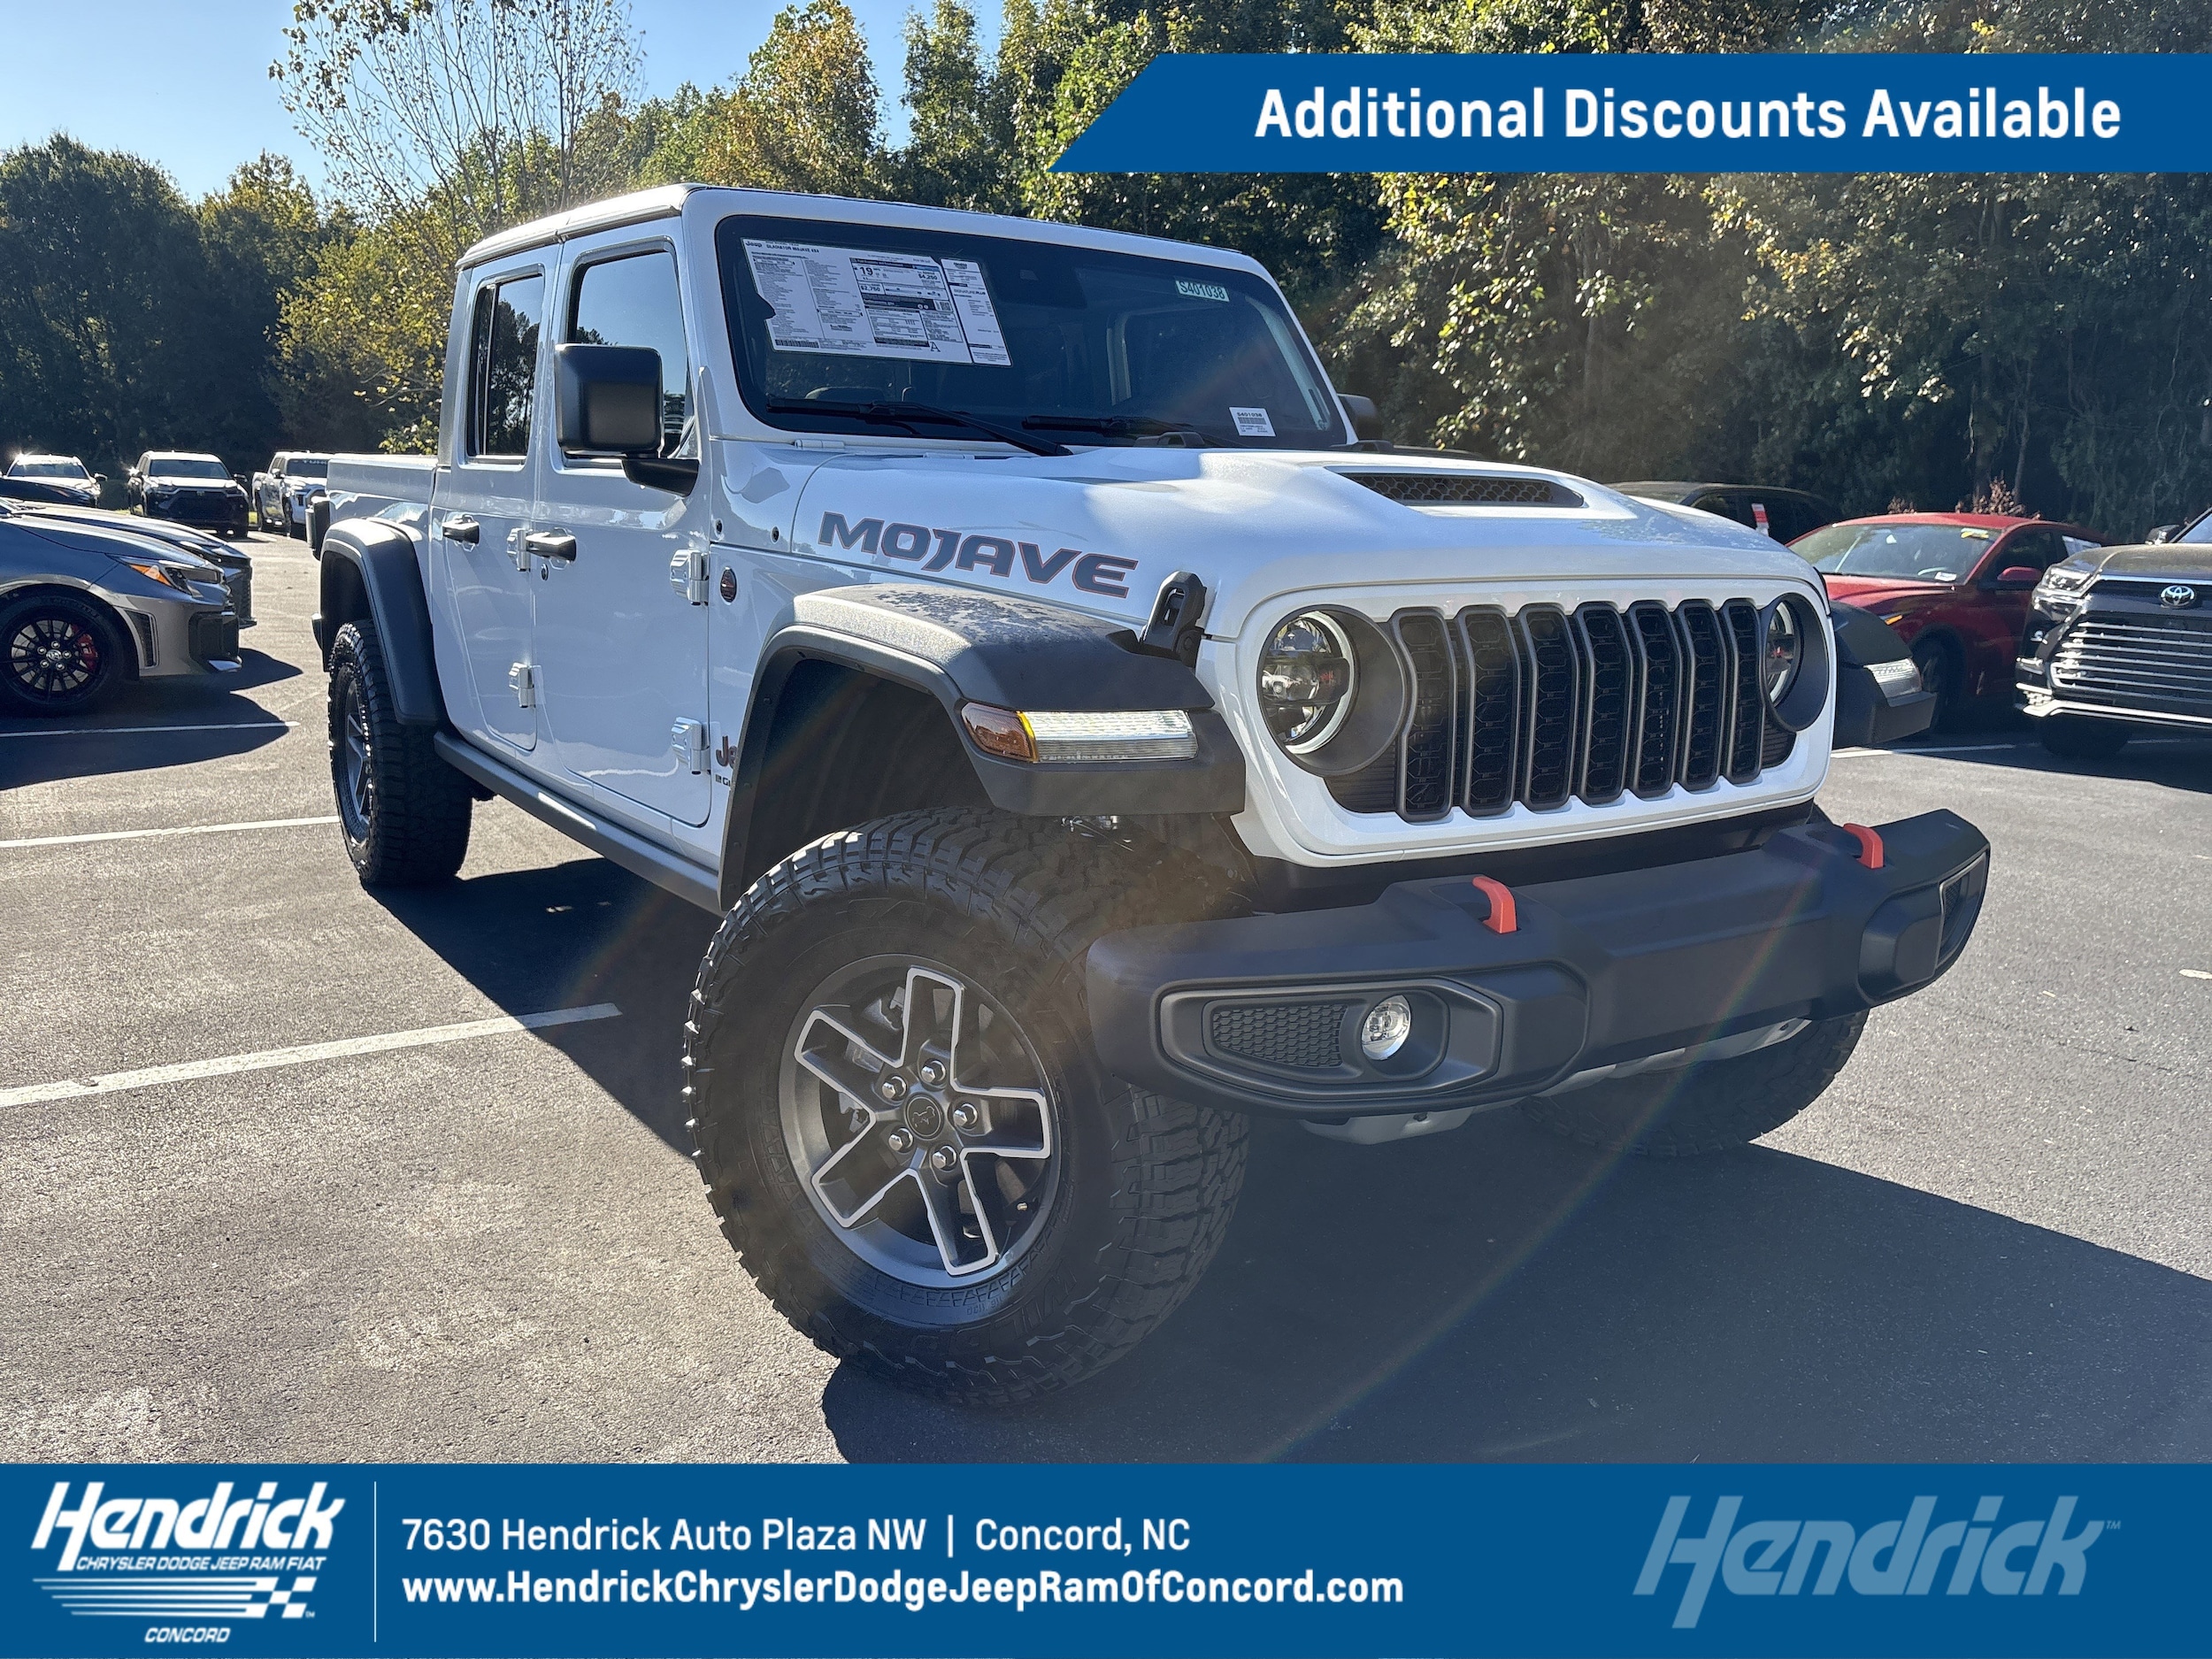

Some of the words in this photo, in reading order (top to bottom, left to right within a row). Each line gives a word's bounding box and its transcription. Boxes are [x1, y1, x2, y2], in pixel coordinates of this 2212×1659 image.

[859, 266, 873, 275] 19
[1179, 280, 1225, 300] S401038
[818, 511, 1140, 599] MOJAVE
[716, 735, 738, 770] Je
